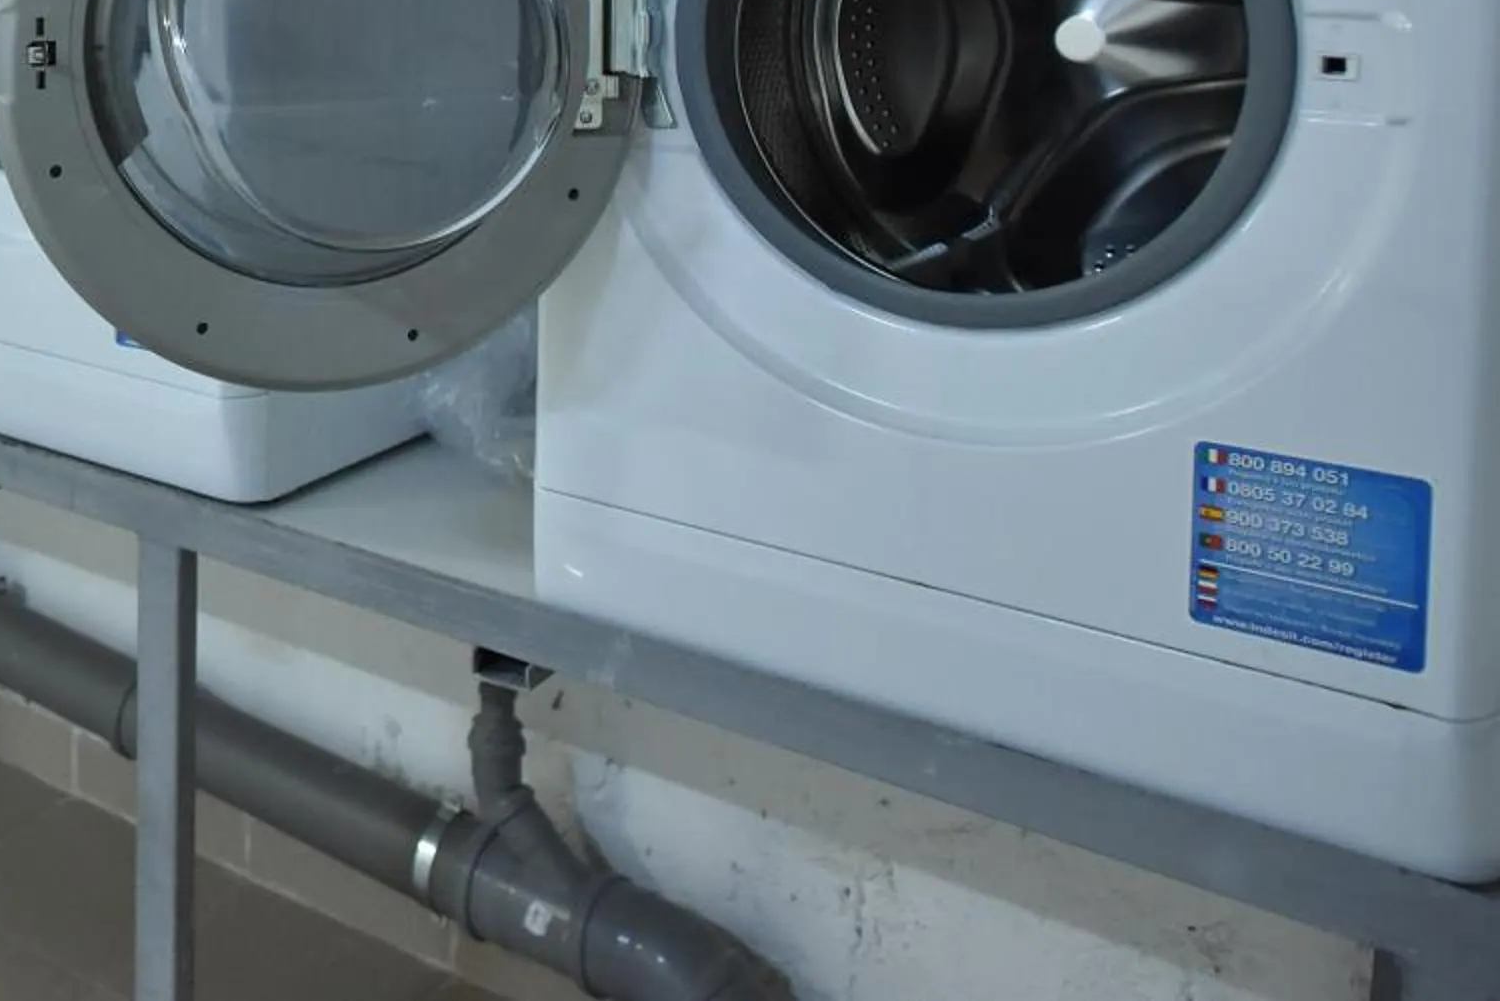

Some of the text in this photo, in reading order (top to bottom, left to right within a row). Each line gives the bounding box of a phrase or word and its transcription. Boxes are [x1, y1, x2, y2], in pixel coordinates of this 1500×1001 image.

[1228, 452, 1264, 472] 800
[1270, 459, 1307, 477] 894
[1312, 468, 1349, 487] 051
[1227, 481, 1276, 502] 0805
[1281, 489, 1306, 505] 37
[1311, 496, 1338, 514] 02
[1226, 507, 1263, 528] 900
[1269, 519, 1305, 538] 373
[1310, 527, 1349, 546] 538
[1225, 537, 1261, 557] 800
[1297, 552, 1323, 572] 22
[1327, 558, 1355, 576] 99
